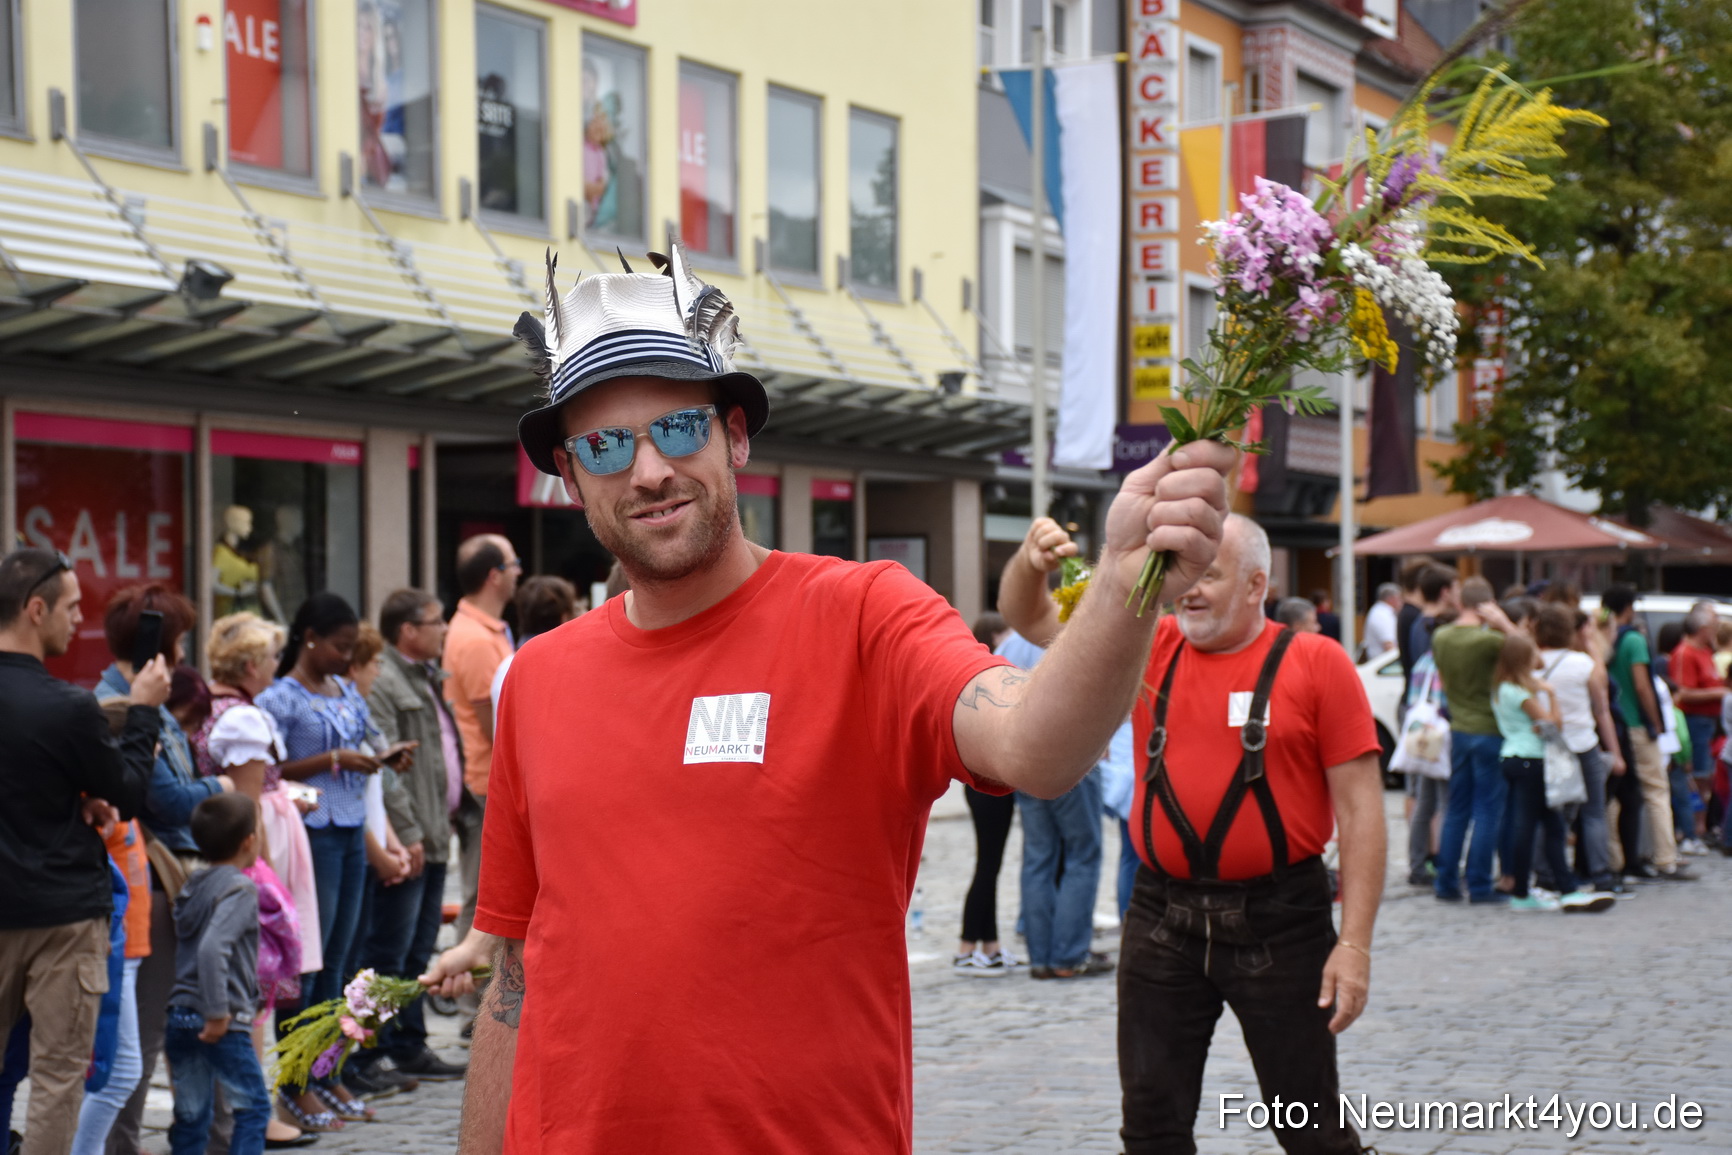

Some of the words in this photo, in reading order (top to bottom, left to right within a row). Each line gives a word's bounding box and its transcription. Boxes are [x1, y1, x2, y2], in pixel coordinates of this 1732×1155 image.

[677, 130, 706, 166] LE
[24, 505, 173, 579] SALE
[685, 744, 751, 757] NEUMARKT
